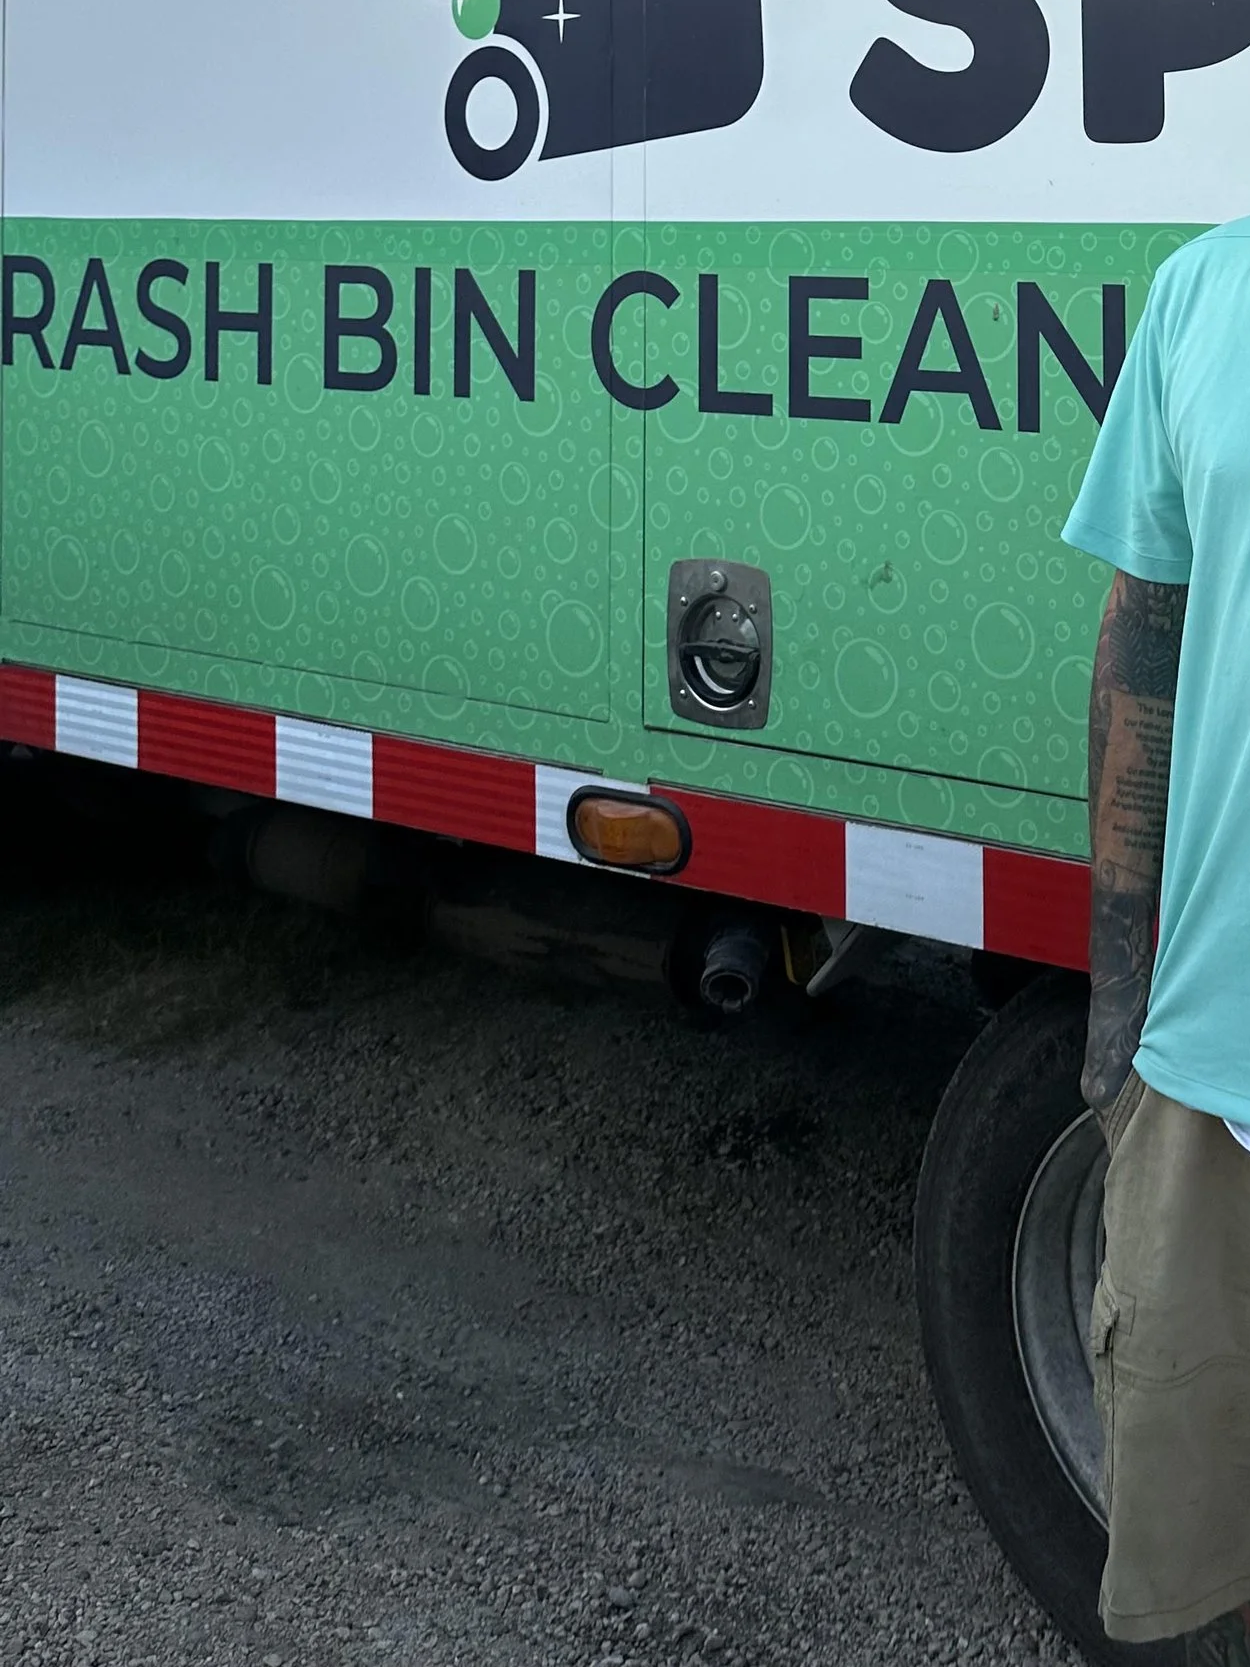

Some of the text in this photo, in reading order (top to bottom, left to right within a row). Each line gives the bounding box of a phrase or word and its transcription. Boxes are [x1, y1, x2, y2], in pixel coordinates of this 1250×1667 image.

[2, 255, 1126, 433] RASH BIN CLEAN
